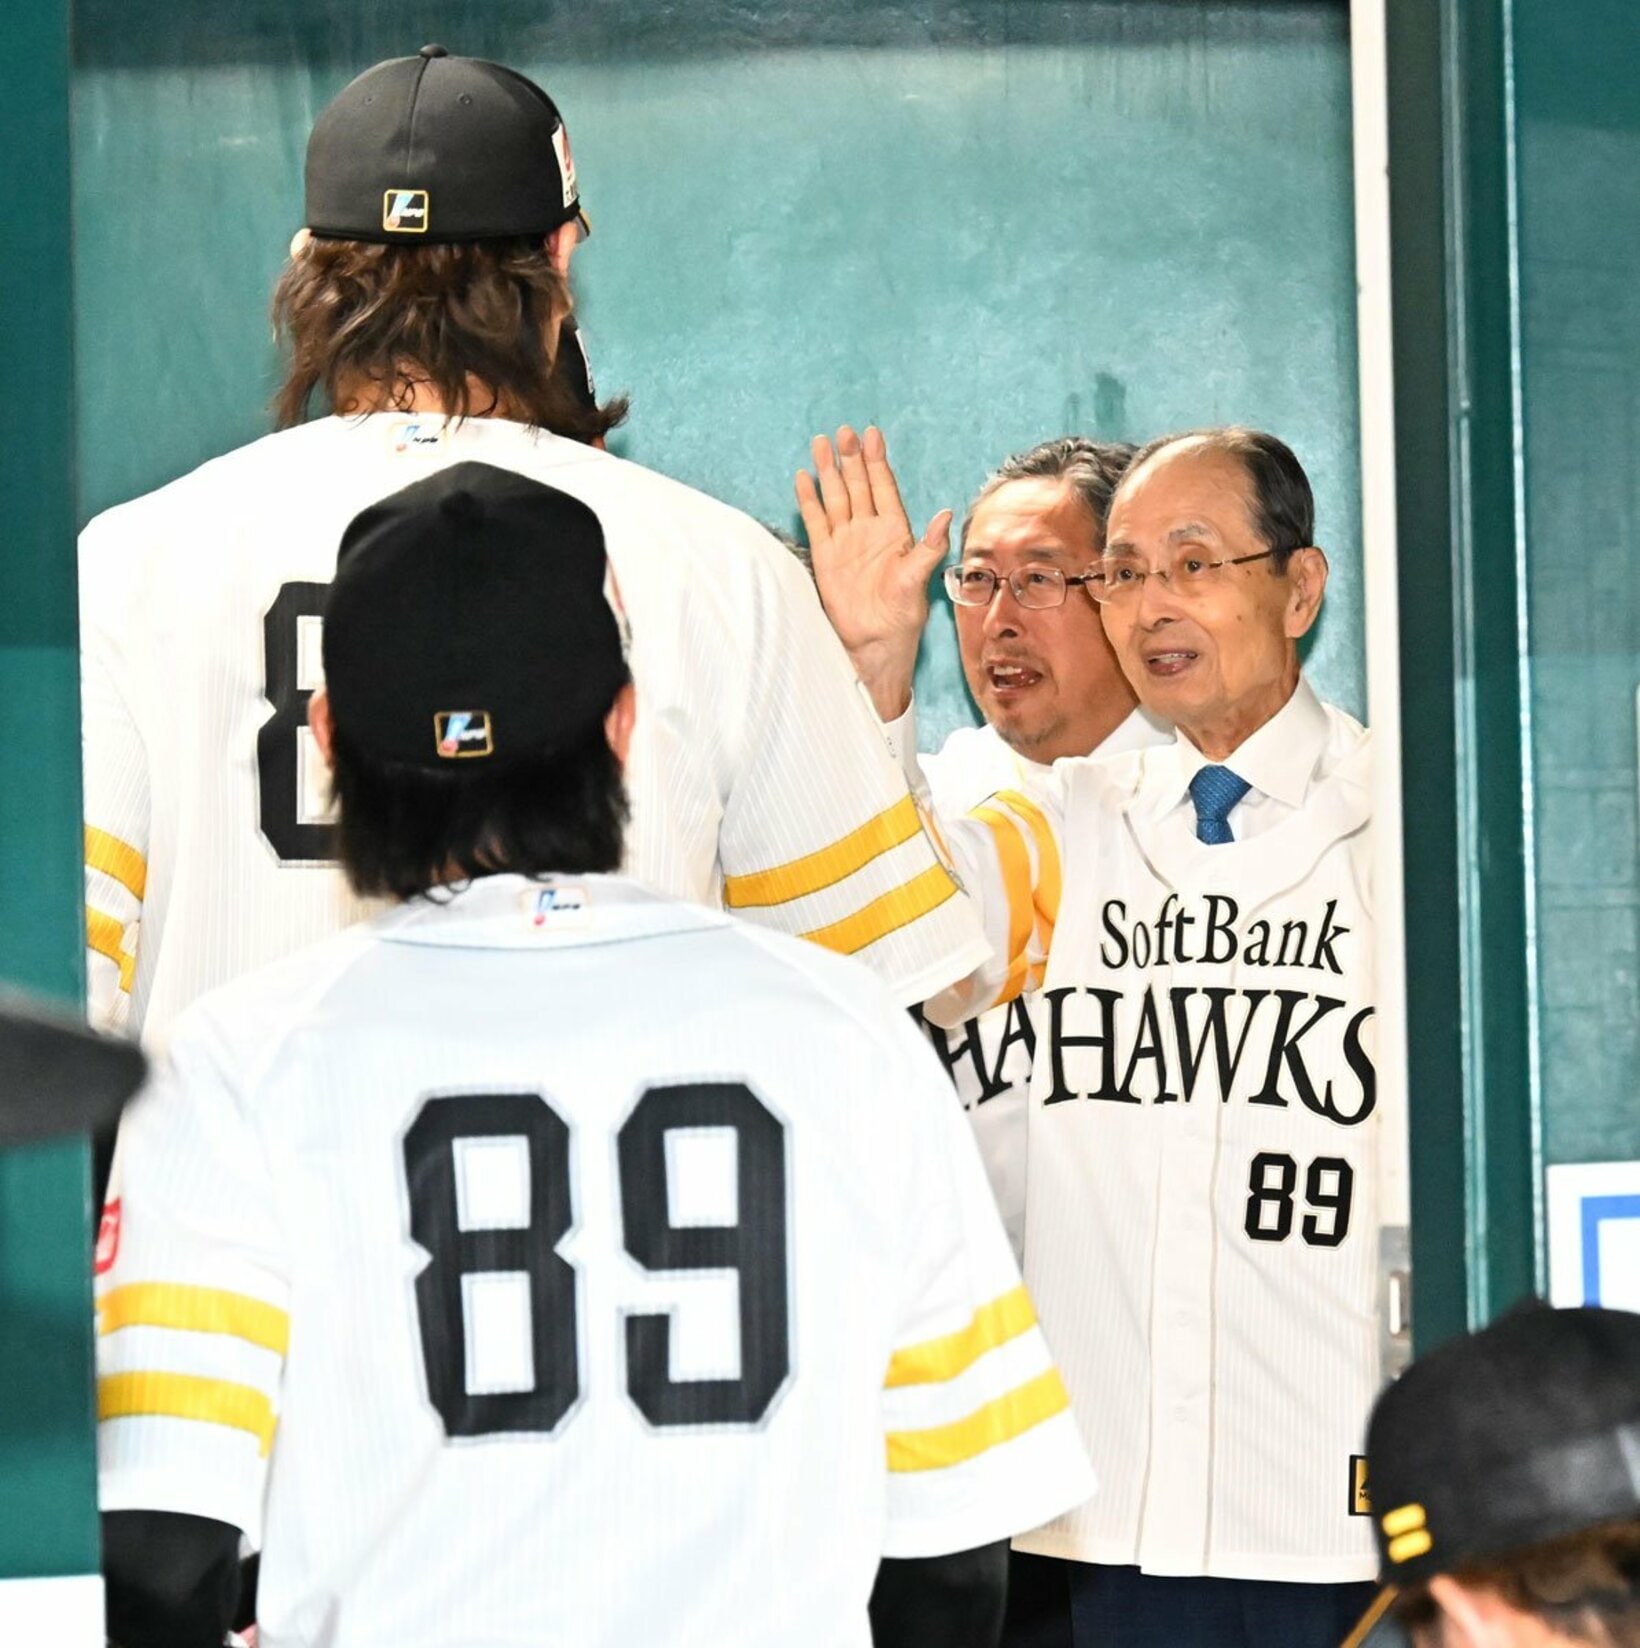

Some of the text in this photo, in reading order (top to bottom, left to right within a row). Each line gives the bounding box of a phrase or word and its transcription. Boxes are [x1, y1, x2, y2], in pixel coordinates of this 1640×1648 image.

[1101, 893, 1351, 975] SoftBank
[1043, 983, 1378, 1126] HAWKS
[1244, 1152, 1354, 1247] 89
[403, 1083, 789, 1437] 89
